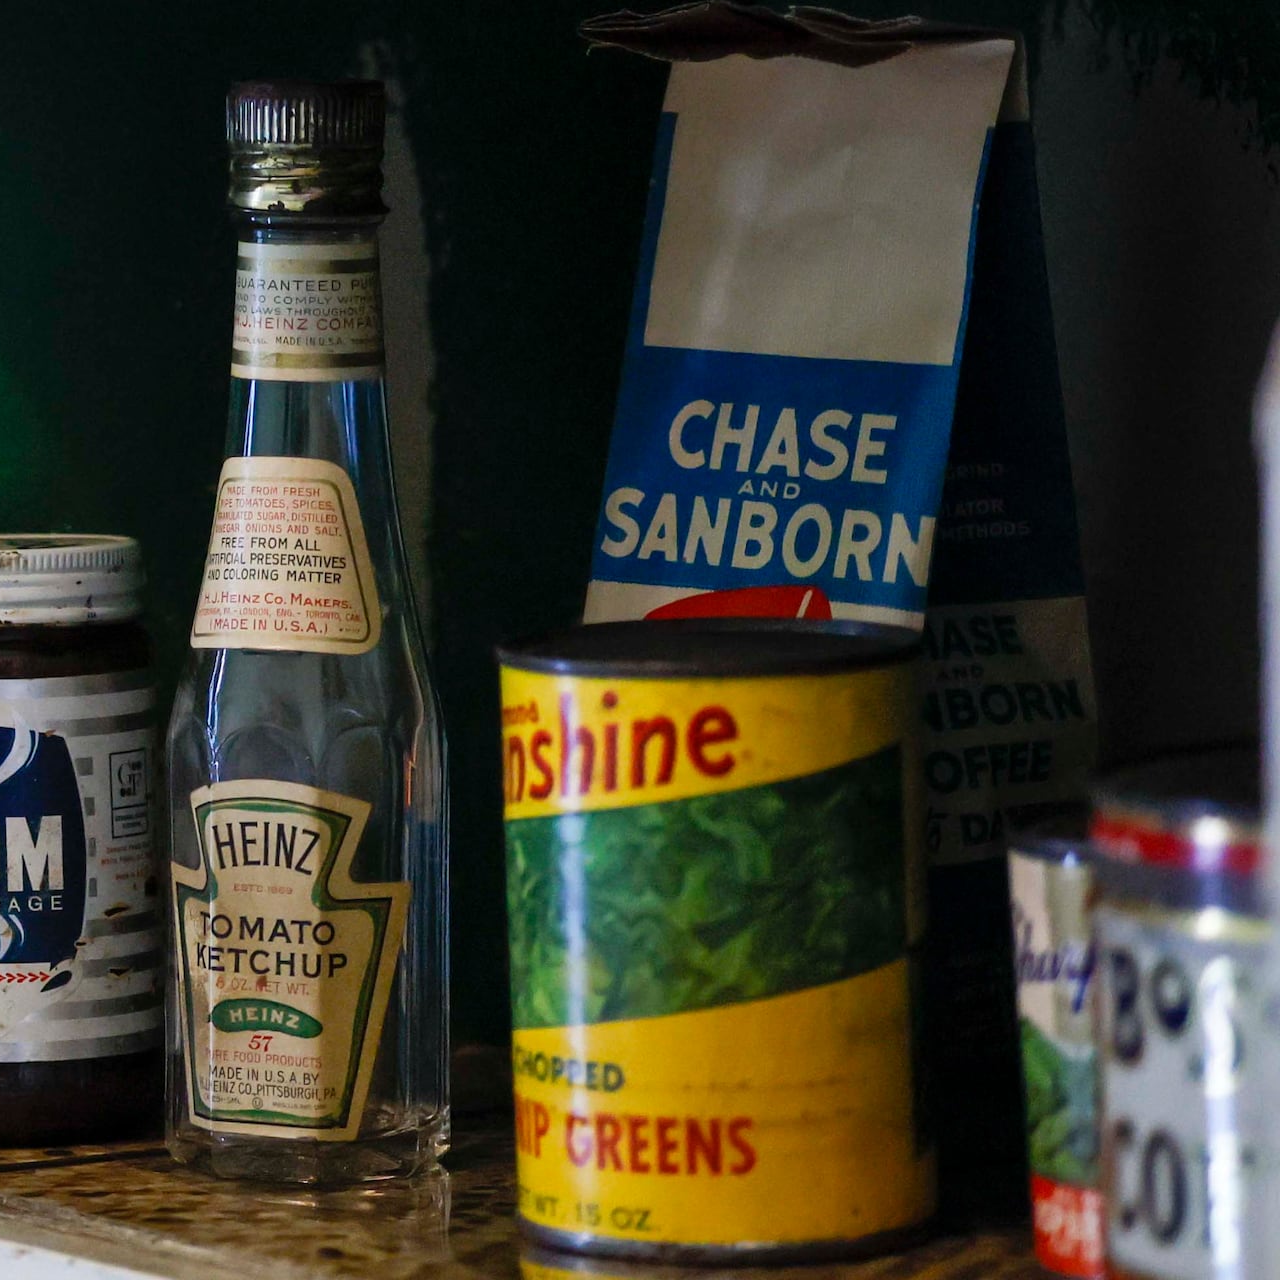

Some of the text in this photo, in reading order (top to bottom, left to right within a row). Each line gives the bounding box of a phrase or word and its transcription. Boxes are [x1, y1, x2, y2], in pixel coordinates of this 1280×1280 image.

[273, 295, 331, 305] COMPLY
[250, 305, 282, 316] LAWS
[275, 336, 302, 346] MADE
[305, 337, 316, 346] IN
[668, 399, 898, 485] CHASE
[251, 486, 278, 496] FROM
[283, 486, 321, 497] FRESH
[738, 478, 802, 500] AND
[236, 499, 336, 513] TOMATOES, SPICES,
[291, 512, 338, 525] DISTILLED
[245, 524, 343, 538] ONIONS AND SALT.
[600, 486, 937, 588] SANBORN
[221, 536, 322, 552] FREE FROM ALL
[249, 553, 347, 570] PRESERVATIVES
[207, 568, 342, 585] AND COLORING MATTER
[290, 593, 353, 610] MAKERS.
[209, 618, 248, 631] (MADE
[252, 620, 268, 632] IN
[212, 821, 321, 875] HEINZ
[200, 911, 336, 946] TOMATO
[196, 942, 349, 980] KETCHUP
[230, 977, 252, 992] OZ.
[287, 981, 310, 996] WT.
[229, 1007, 301, 1030] HEINZ
[248, 1034, 274, 1052] 57
[233, 1050, 323, 1070] FOOD PRODUCTS
[208, 1064, 243, 1080] MADE
[246, 1068, 259, 1082] IN
[566, 1111, 758, 1176] GREENS
